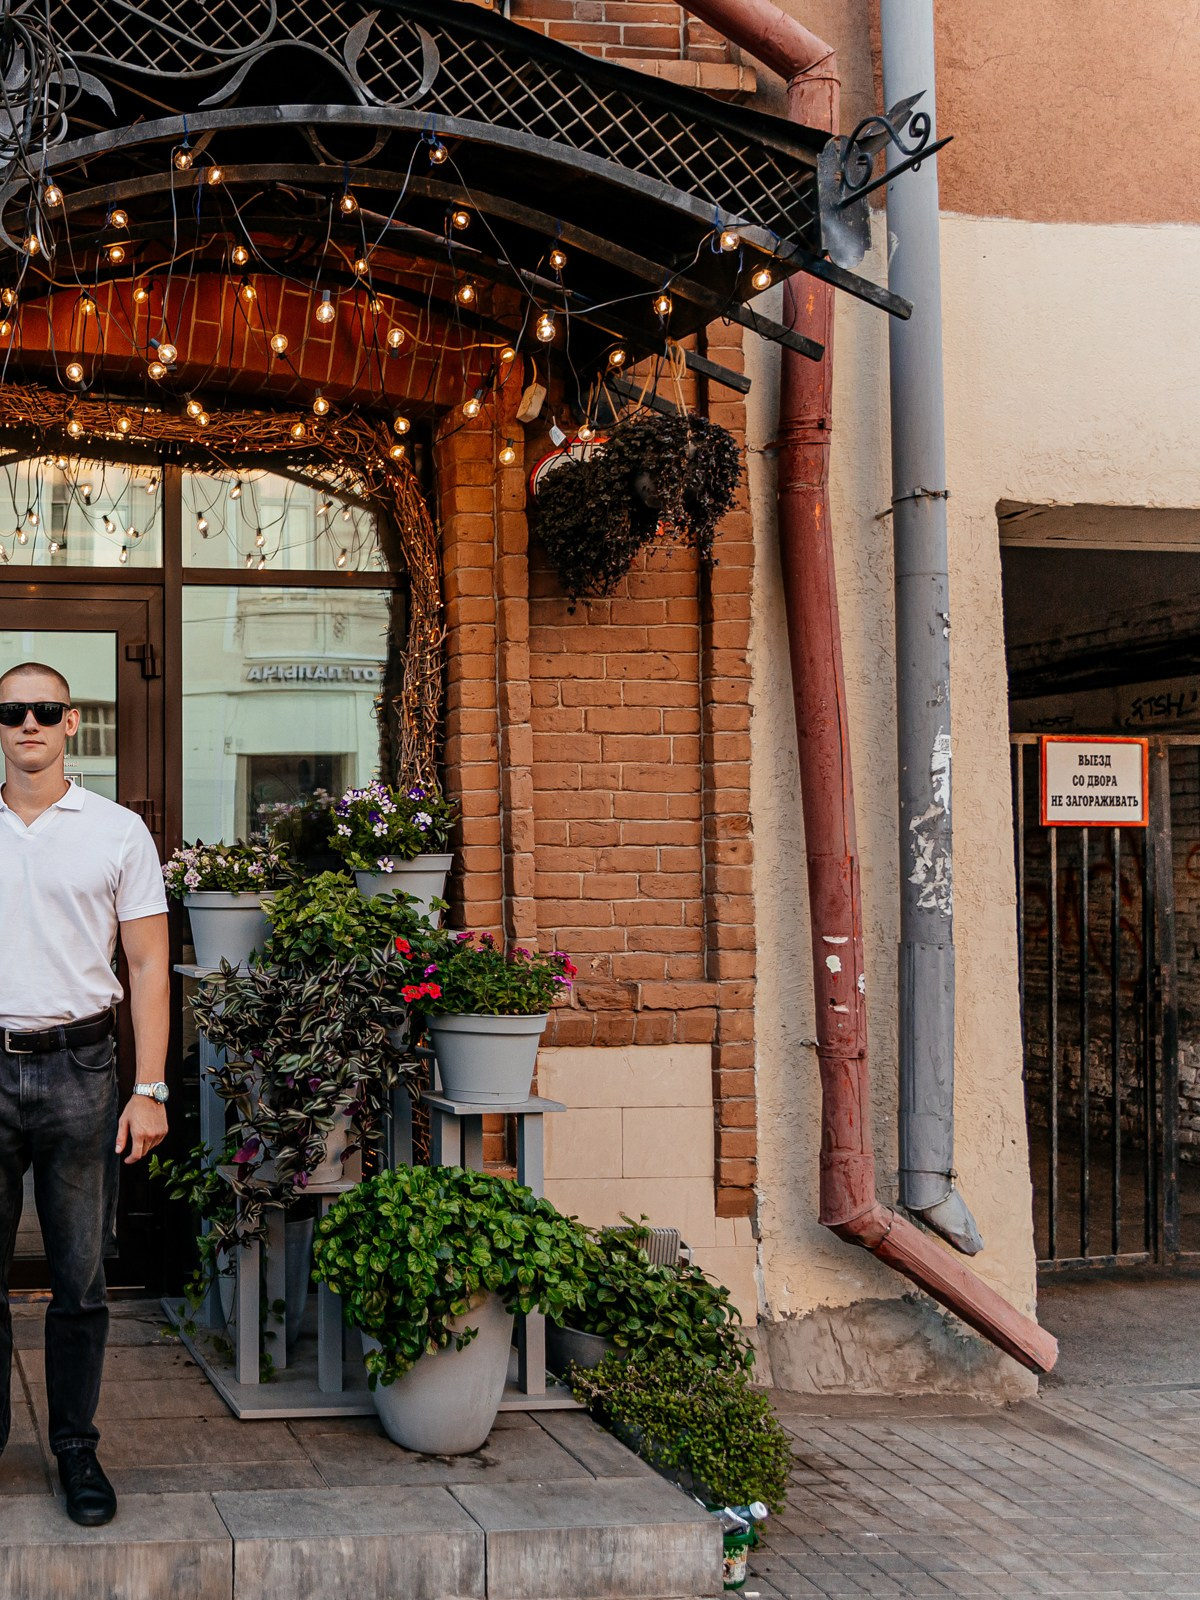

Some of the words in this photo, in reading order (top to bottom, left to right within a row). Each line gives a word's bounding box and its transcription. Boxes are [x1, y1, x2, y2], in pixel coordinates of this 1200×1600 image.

[1078, 755, 1111, 767] ВЫЕЗД
[1072, 775, 1085, 787] СО
[1087, 775, 1118, 788] ДВОРА
[1051, 795, 1064, 807] НЕ
[1066, 795, 1139, 807] ЗАГОРАЖИВАТЬ
